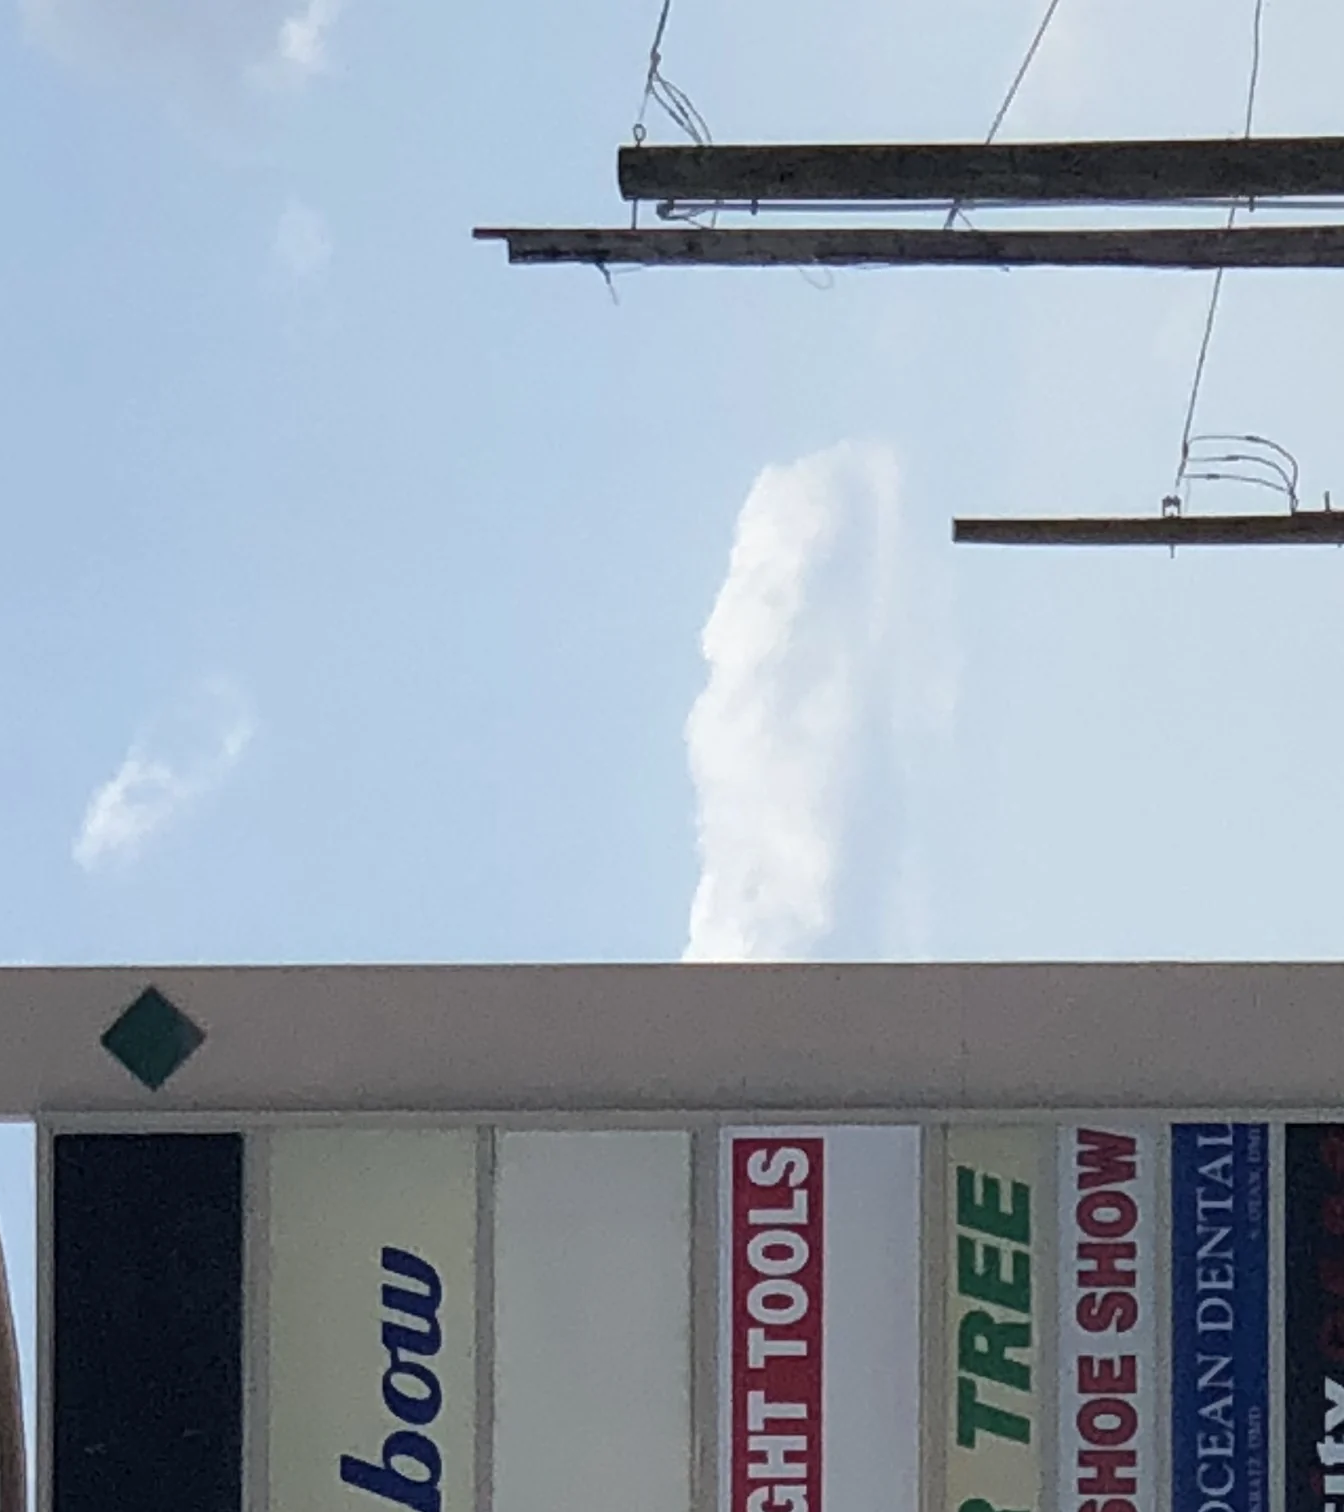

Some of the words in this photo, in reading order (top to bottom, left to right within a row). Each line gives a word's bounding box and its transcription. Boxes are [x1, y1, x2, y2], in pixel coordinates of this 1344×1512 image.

[746, 1145, 811, 1368] TOOLS
[955, 1165, 1033, 1450] TREE
[1076, 1128, 1138, 1333] SHOW
[1196, 1122, 1235, 1332] DENTAL
